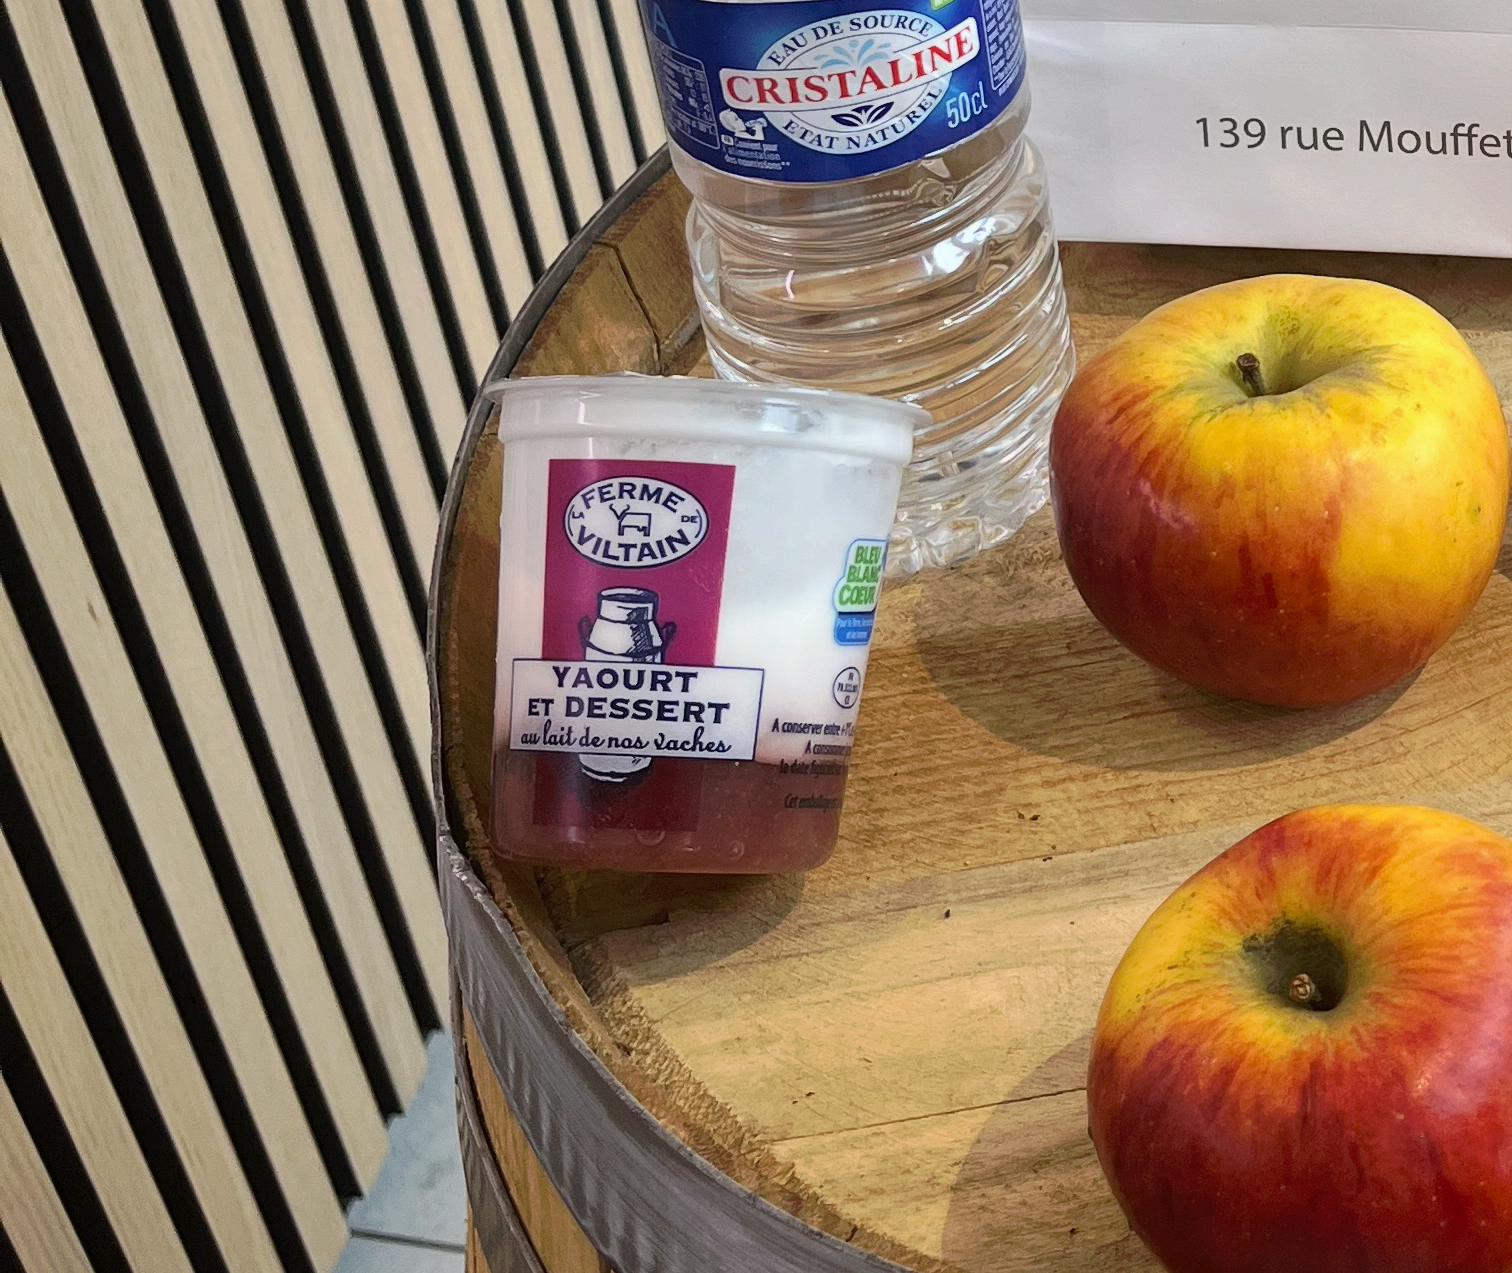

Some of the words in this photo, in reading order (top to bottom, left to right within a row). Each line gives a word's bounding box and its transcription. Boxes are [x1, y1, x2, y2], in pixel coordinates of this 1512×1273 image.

[767, 32, 808, 67] EAU
[812, 20, 844, 38] DE
[849, 14, 934, 38] SOURCE
[726, 25, 974, 105] CRISTALINE
[782, 118, 840, 150] ETAT
[846, 87, 943, 150] NATUREL
[946, 80, 988, 129] 50cl
[1195, 117, 1267, 149] 139
[1279, 124, 1345, 153] rue
[580, 482, 687, 514] FERME
[572, 511, 585, 519] LA
[681, 515, 699, 524] DE
[577, 524, 691, 563] VILTAIN
[854, 545, 882, 565] BLEU
[838, 583, 876, 607] COEUR
[552, 665, 699, 693] YAOURT
[528, 698, 555, 717] ET
[565, 695, 731, 725] DESSERT
[521, 733, 542, 746] au
[542, 718, 578, 747] lait
[578, 726, 606, 749] de
[607, 734, 651, 751] nos
[653, 725, 732, 754] vaches
[771, 717, 780, 733] A
[781, 721, 824, 735] conserver
[804, 739, 812, 755] A
